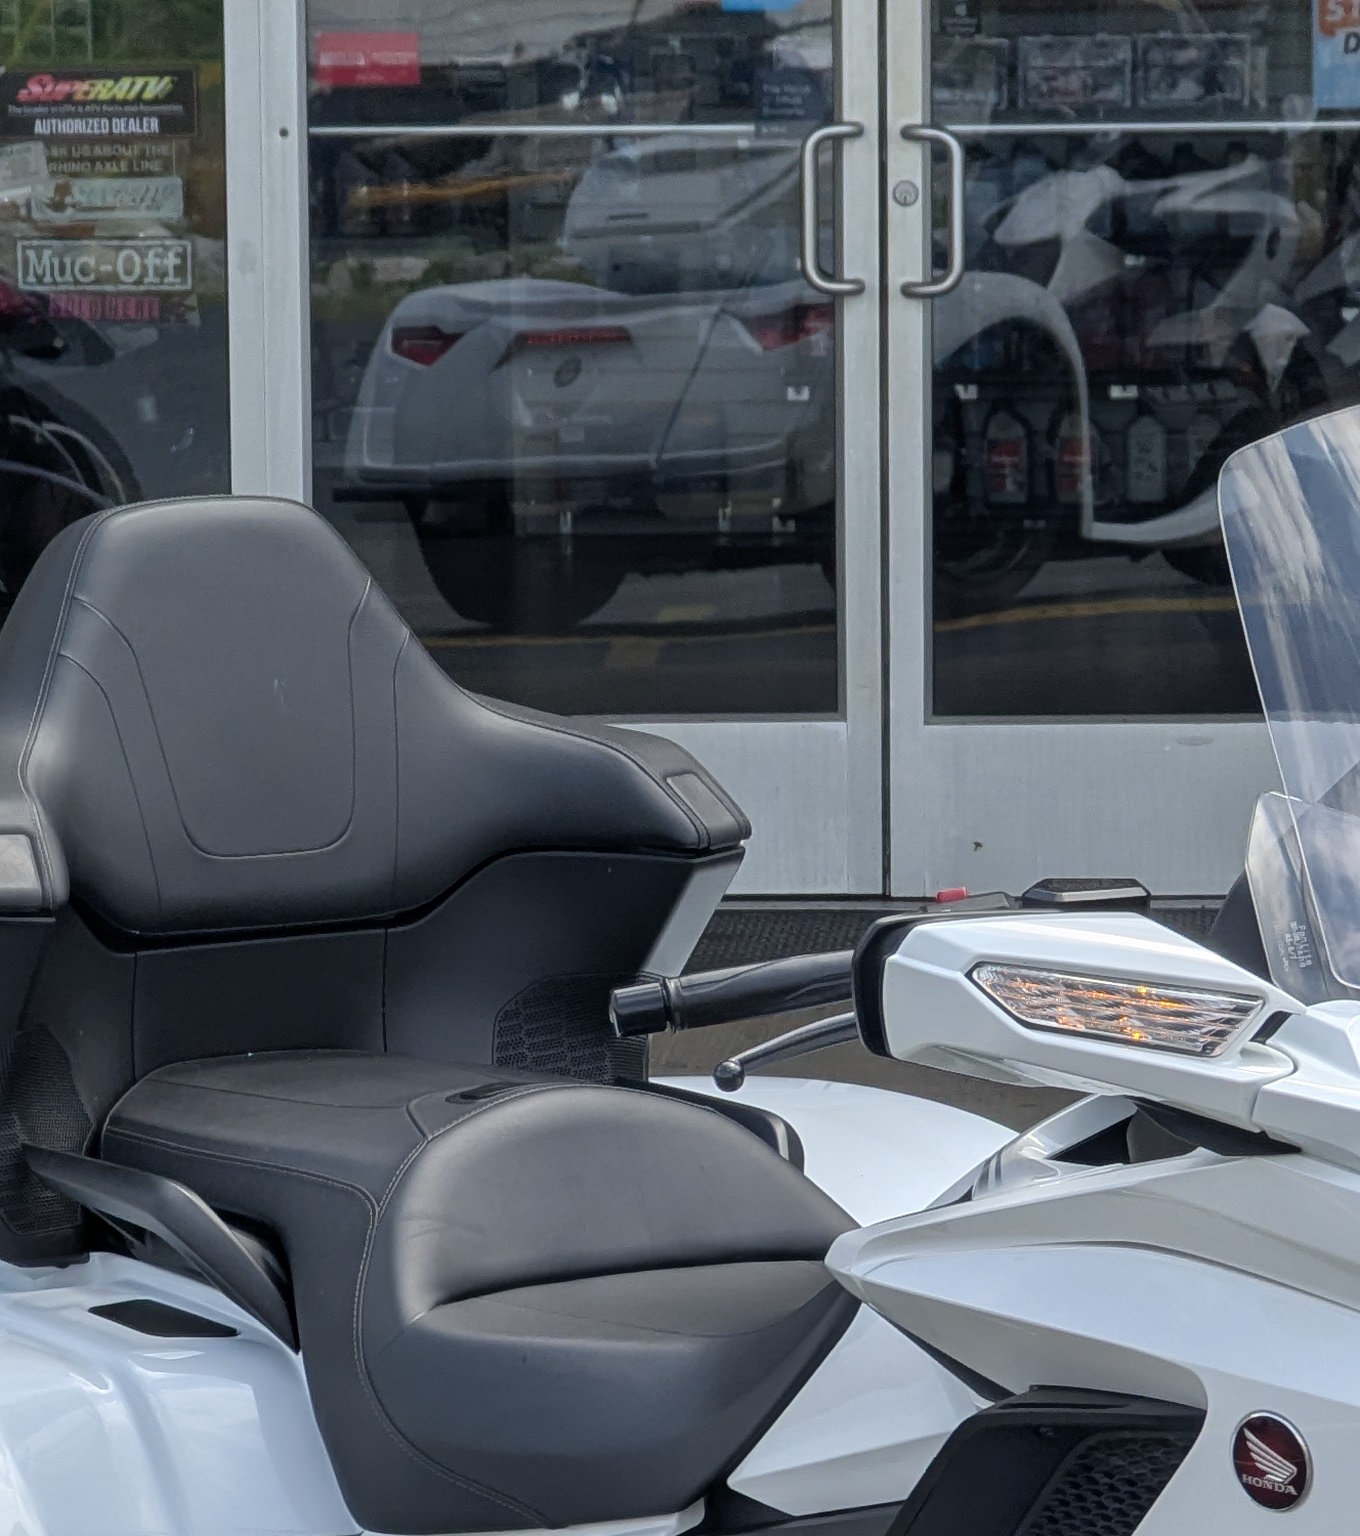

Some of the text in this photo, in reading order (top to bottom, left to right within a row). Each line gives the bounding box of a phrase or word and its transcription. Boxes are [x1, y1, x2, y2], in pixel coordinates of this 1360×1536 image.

[34, 116, 160, 134] AUTHORIZED DEALER
[25, 247, 184, 284] Muc-Off
[1241, 1473, 1298, 1496] HONDA
